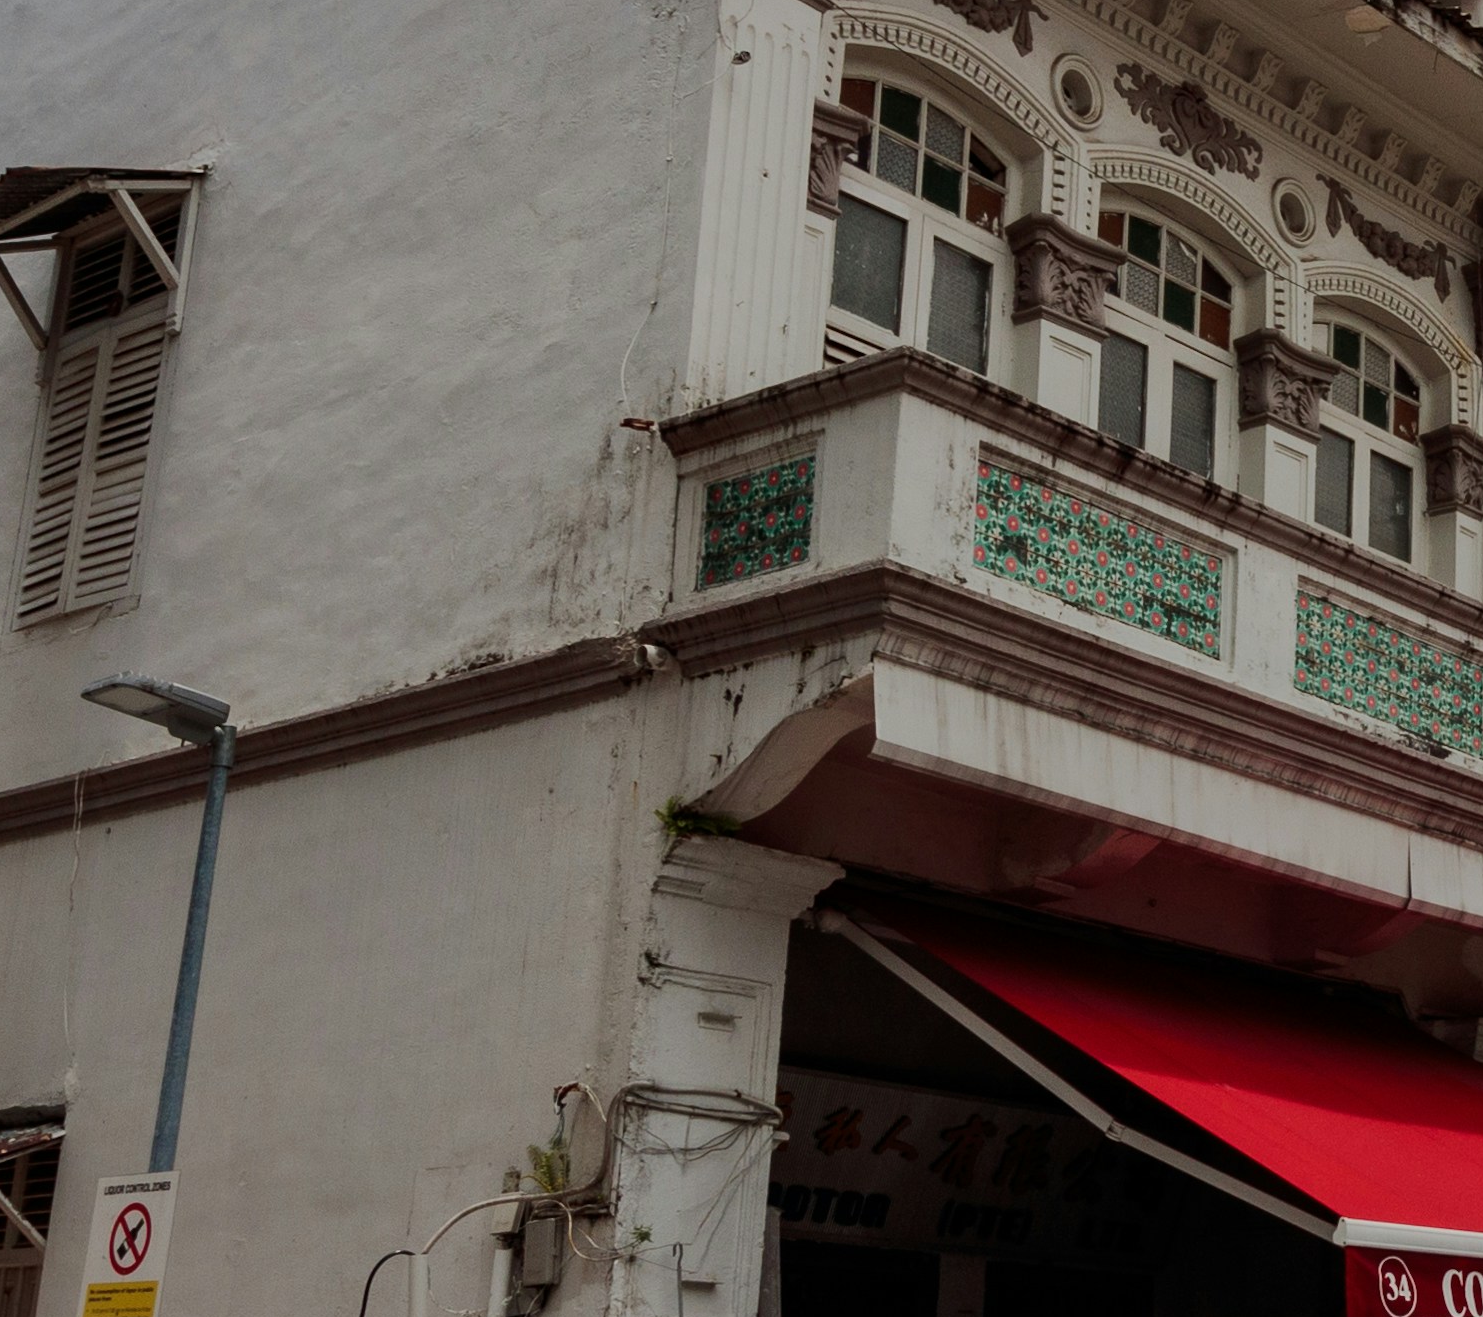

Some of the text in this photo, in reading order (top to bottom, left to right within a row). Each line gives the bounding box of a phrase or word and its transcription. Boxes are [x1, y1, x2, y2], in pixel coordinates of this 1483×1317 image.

[104, 1181, 171, 1196] LIQUOR CONTROL ZONES
[1385, 1272, 1412, 1302] 34
